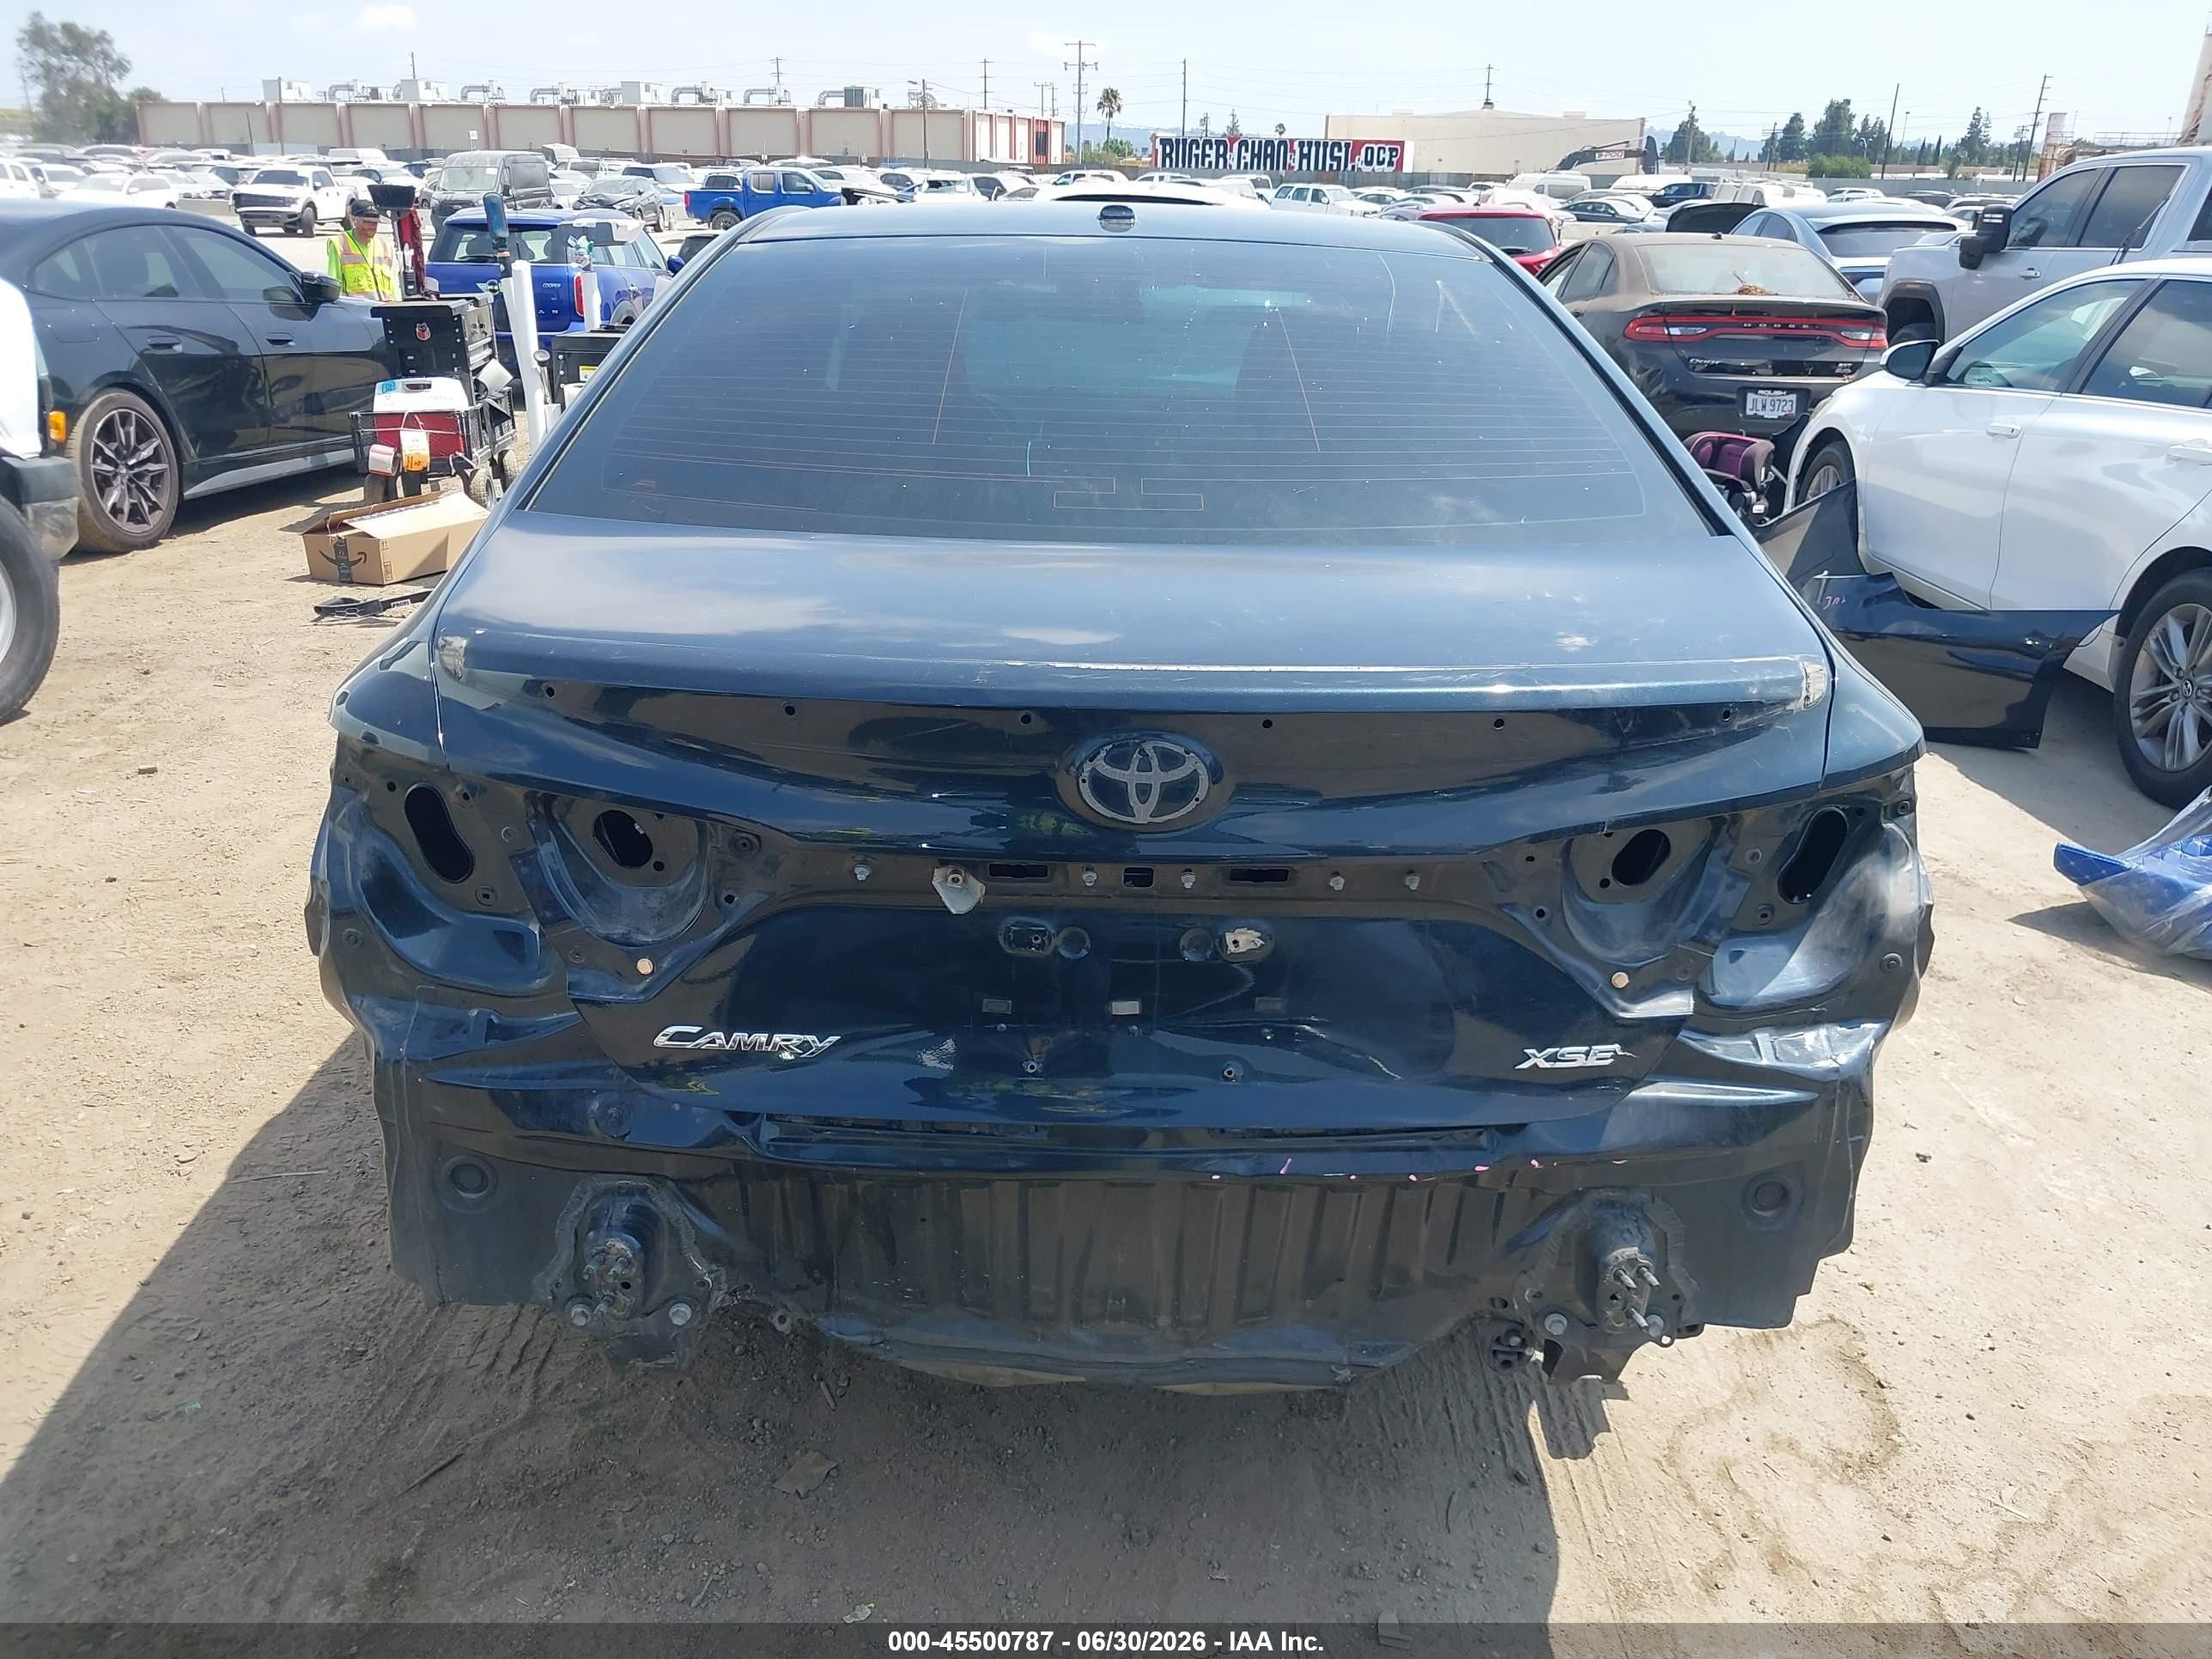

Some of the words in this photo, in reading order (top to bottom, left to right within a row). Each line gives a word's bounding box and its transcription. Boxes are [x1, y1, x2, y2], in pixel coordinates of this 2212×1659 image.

[1364, 145, 1400, 167] OCP
[1748, 398, 1767, 412] JLW
[1769, 398, 1794, 413] 9723
[653, 1024, 842, 1058] CAMRY
[1514, 1042, 1620, 1070] XSE
